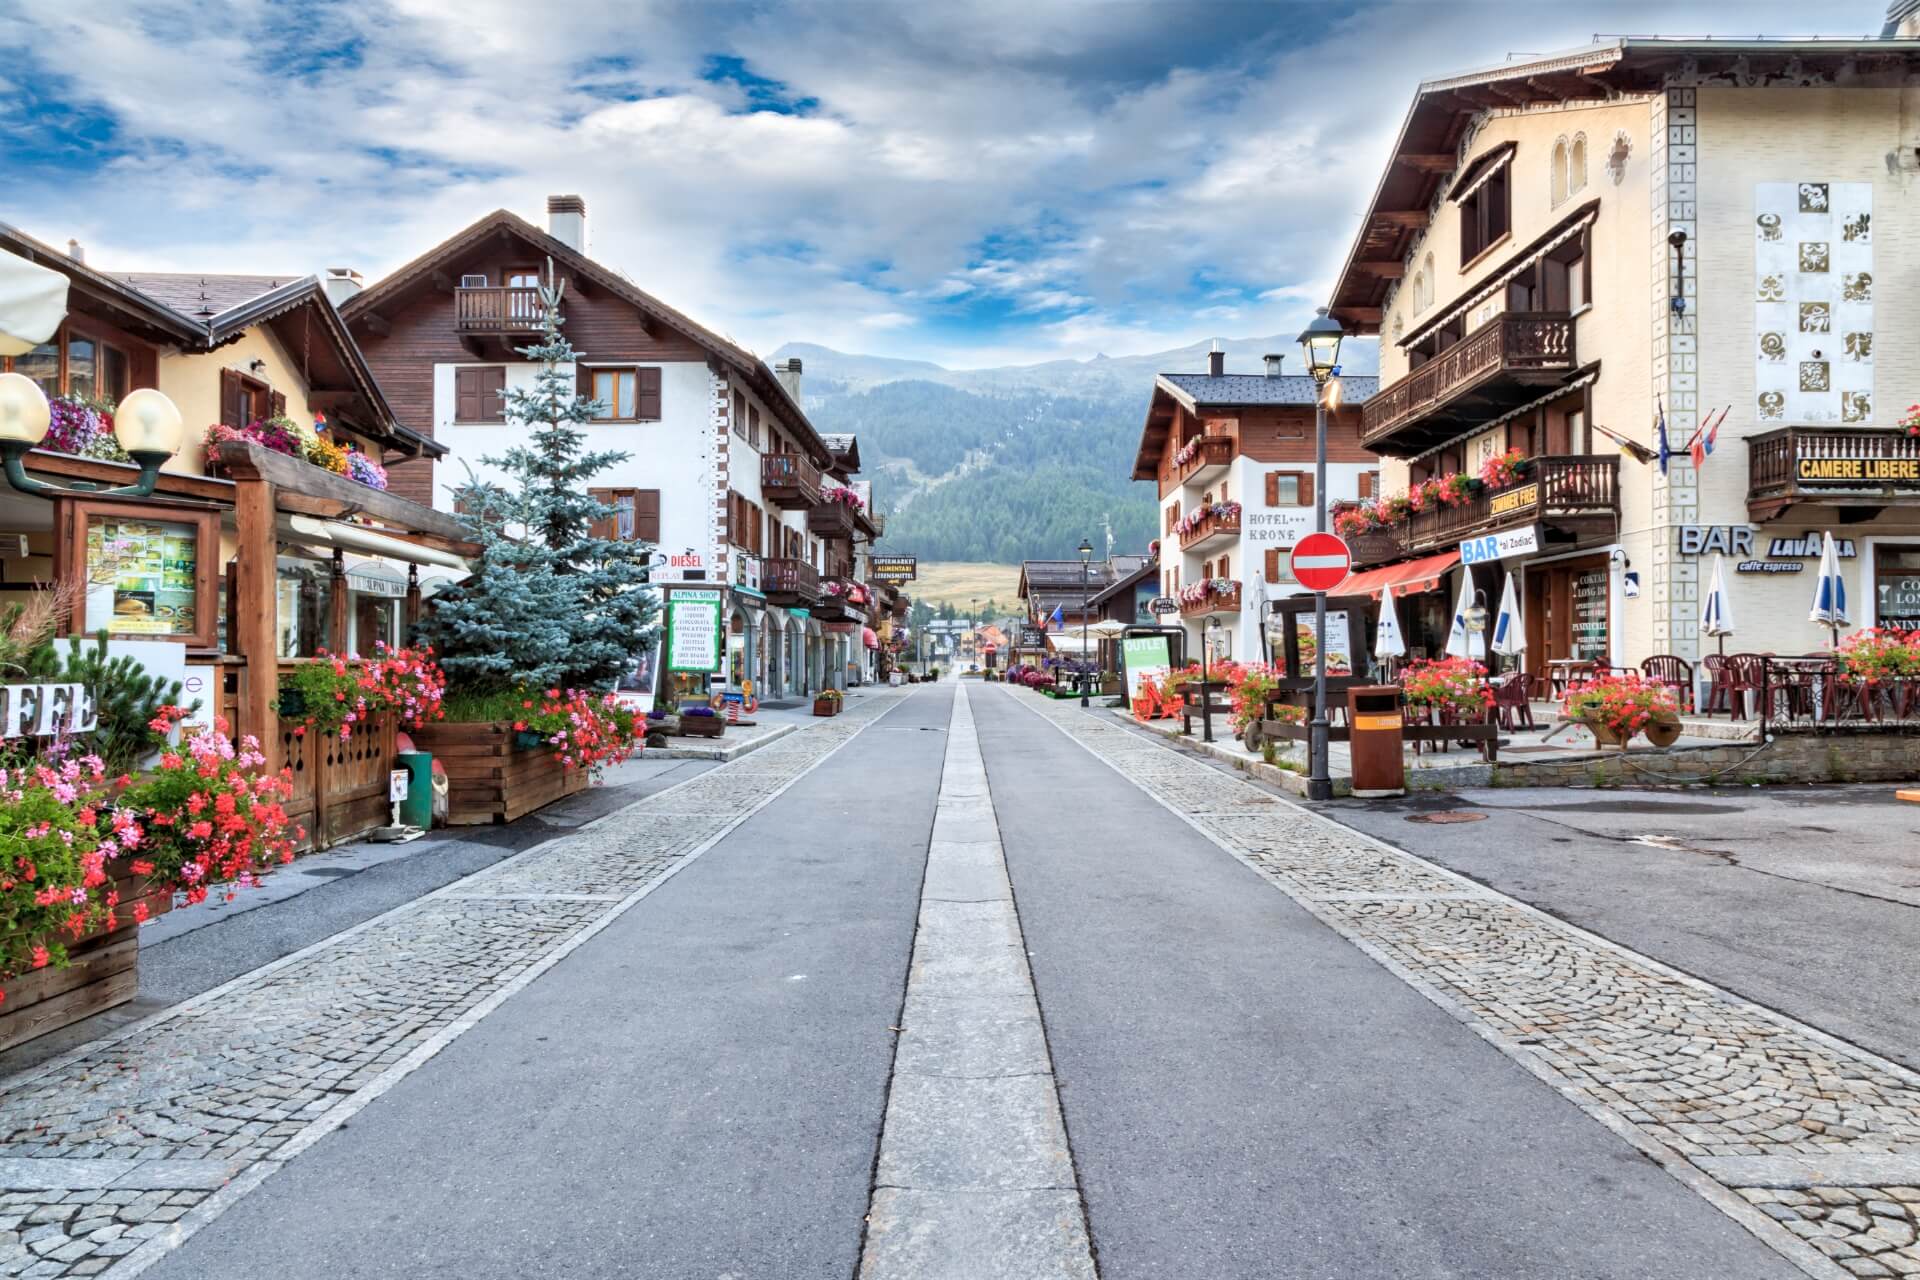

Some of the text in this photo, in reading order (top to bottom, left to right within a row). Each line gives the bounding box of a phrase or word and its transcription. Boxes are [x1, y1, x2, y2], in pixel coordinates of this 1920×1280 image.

[1800, 460, 1919, 478] CAMERE LIBERE
[1491, 492, 1519, 514] ZIMMER
[1249, 514, 1288, 524] HOTEL
[1249, 530, 1295, 540] KRONE
[1679, 526, 1753, 556] BAR
[1462, 536, 1498, 564] BAR
[671, 555, 702, 566] DIESEL
[1763, 562, 1802, 572] espresso
[1127, 640, 1165, 652] OUTLET
